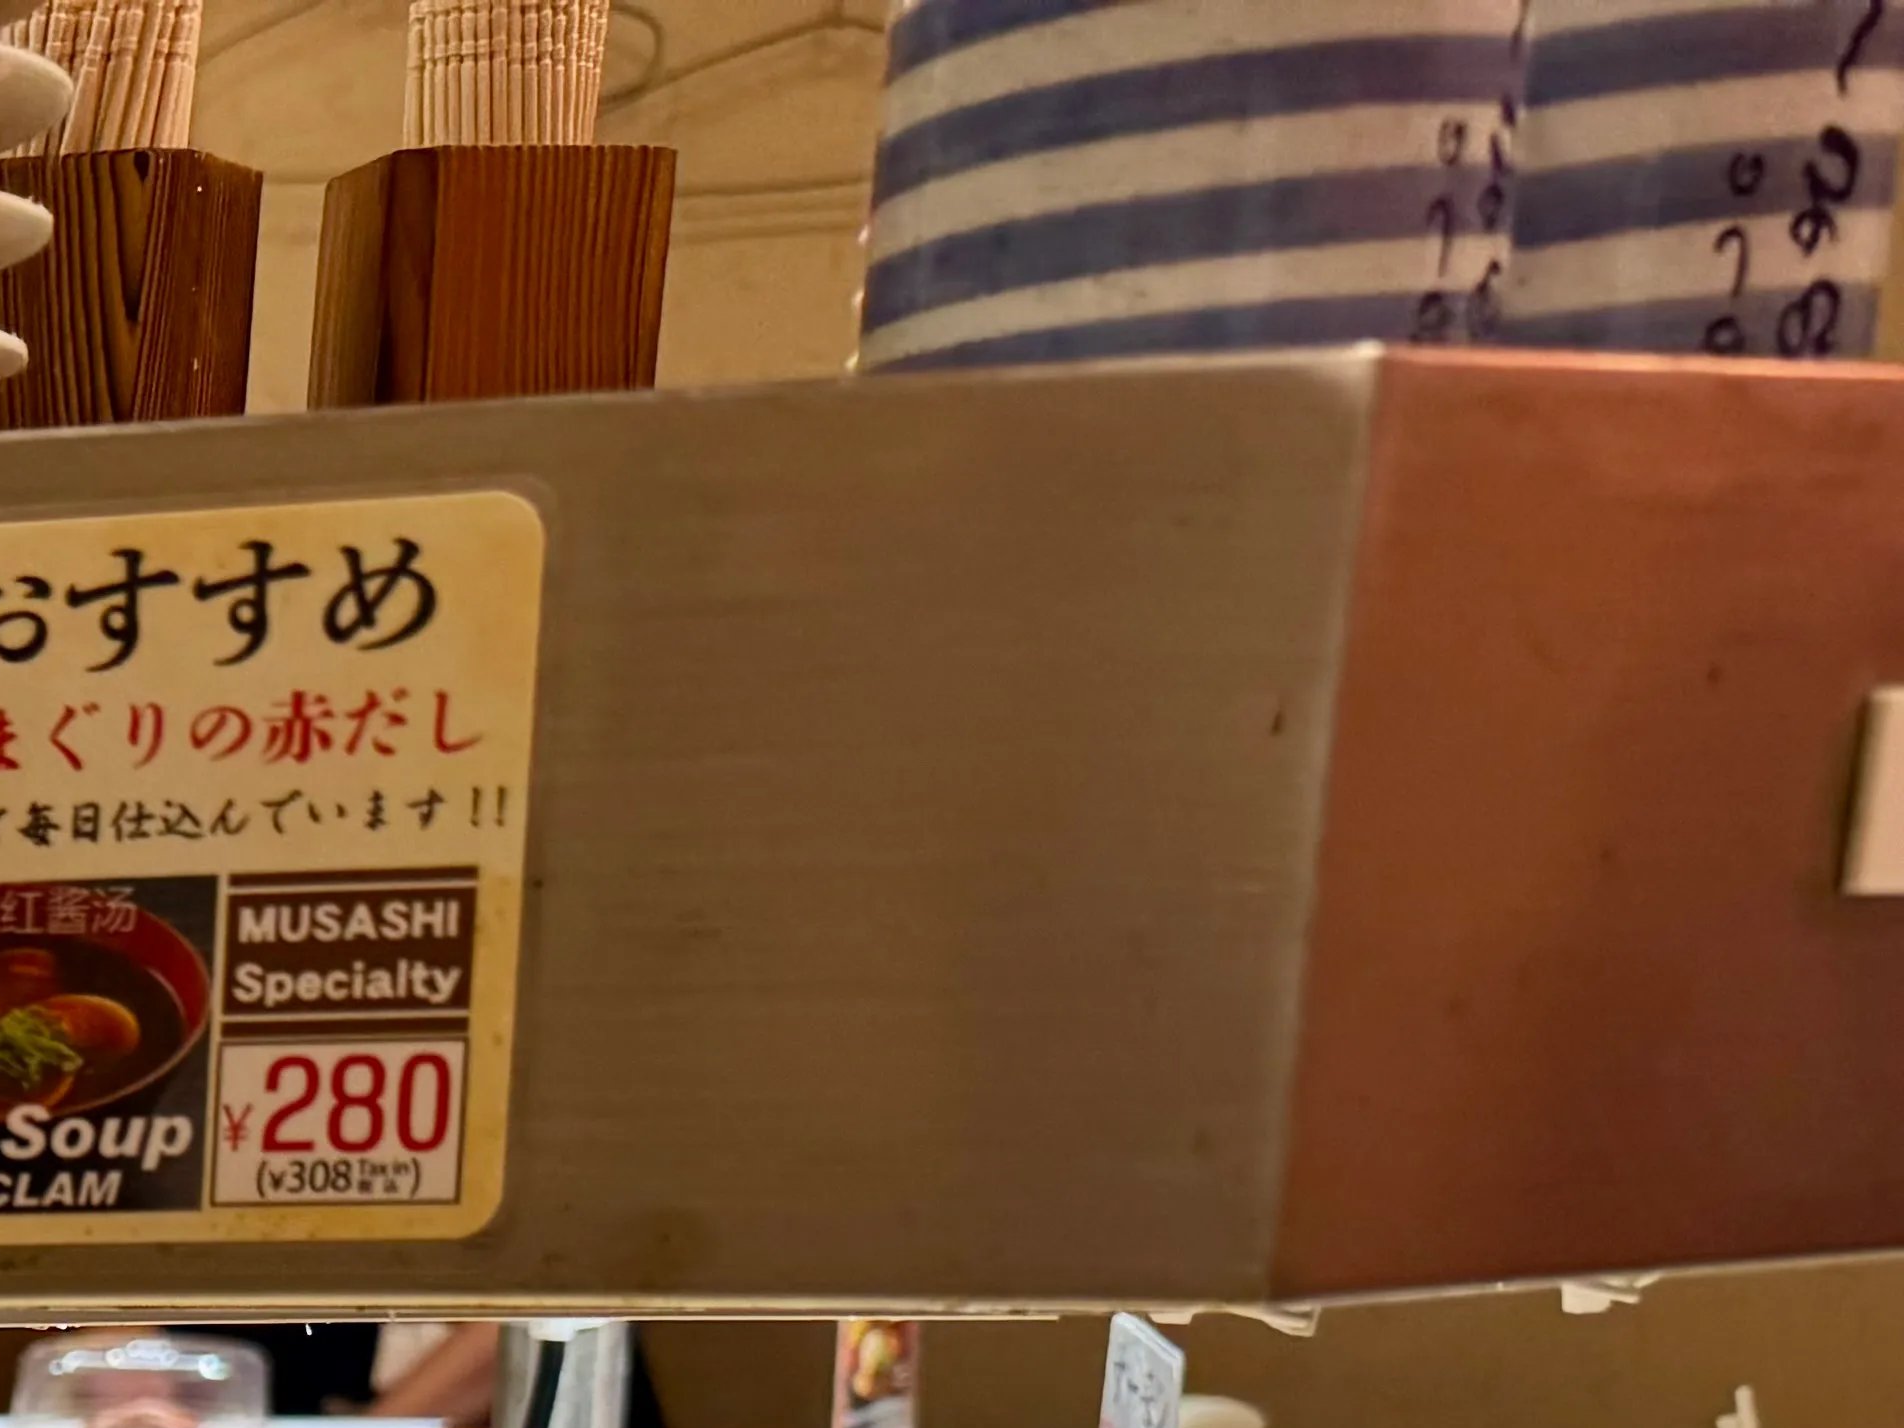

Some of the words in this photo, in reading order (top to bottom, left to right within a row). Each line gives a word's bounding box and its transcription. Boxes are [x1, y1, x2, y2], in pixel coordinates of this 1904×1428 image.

[236, 897, 460, 948] MUSASHI
[232, 959, 461, 1007] Specialty
[222, 1051, 452, 1153] ¥280
